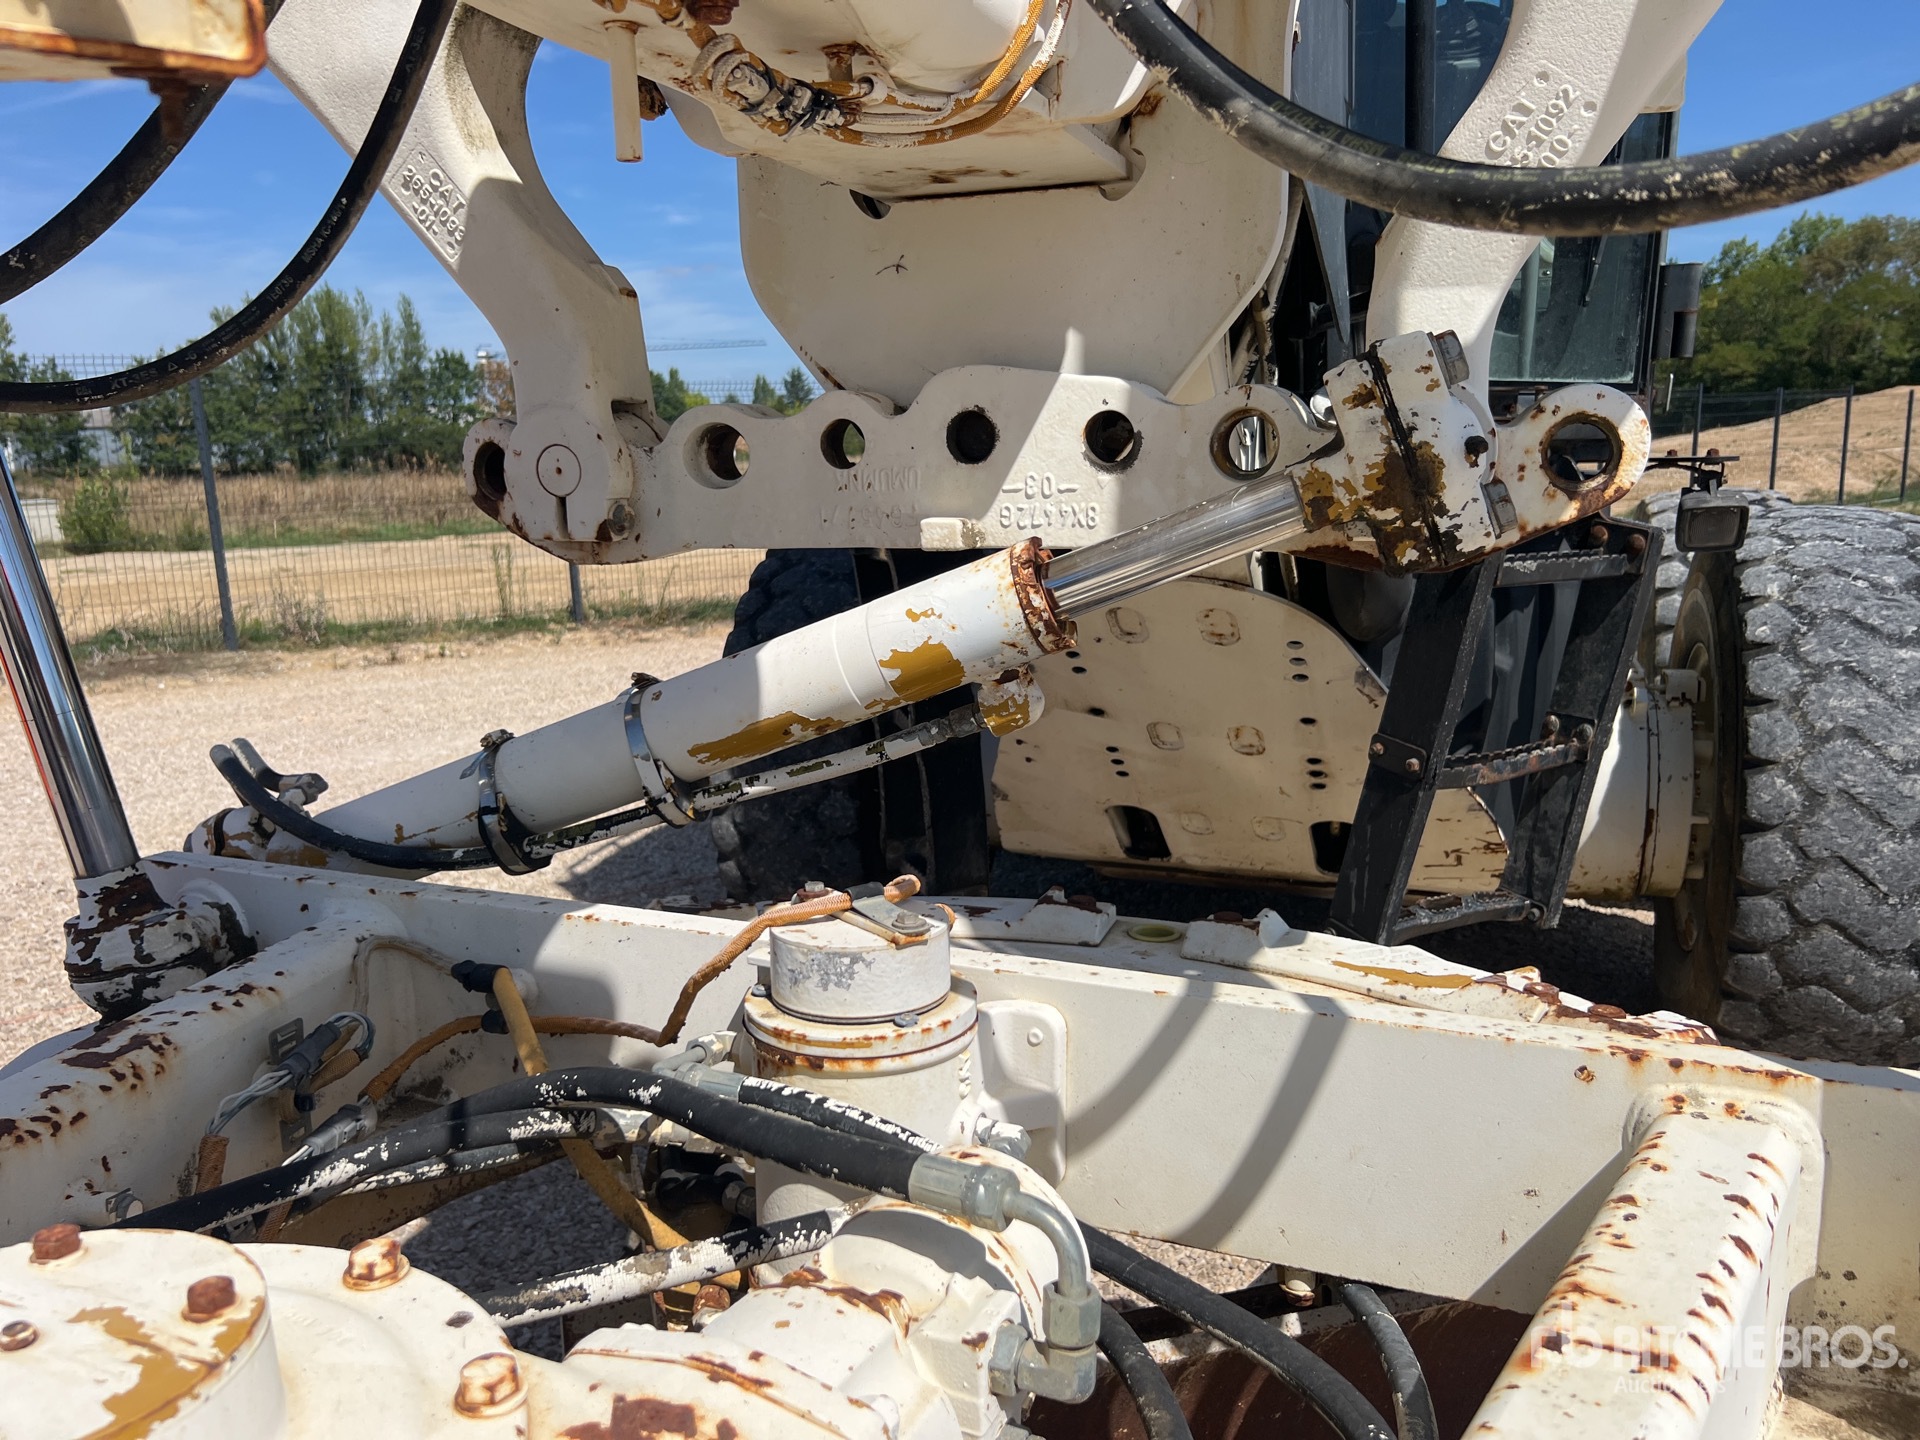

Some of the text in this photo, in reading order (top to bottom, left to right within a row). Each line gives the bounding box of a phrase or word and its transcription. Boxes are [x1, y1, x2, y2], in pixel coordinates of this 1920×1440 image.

[1506, 84, 1580, 167] 5-1092
[428, 168, 467, 210] CAT
[1001, 471, 1081, 499] -03-
